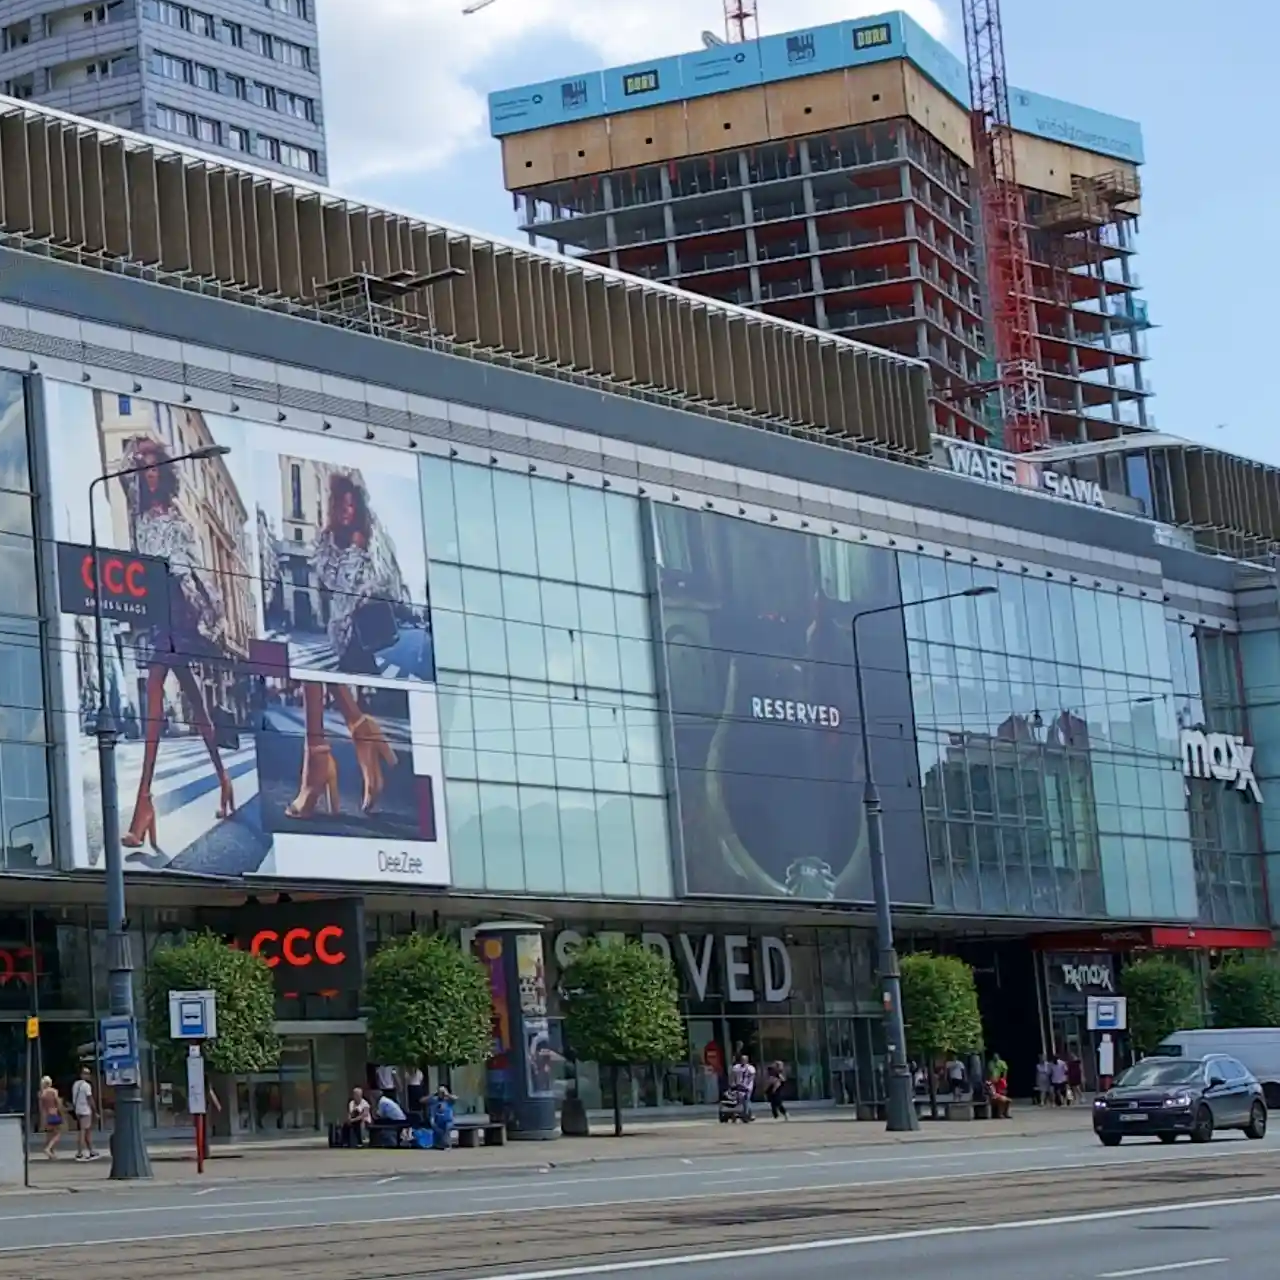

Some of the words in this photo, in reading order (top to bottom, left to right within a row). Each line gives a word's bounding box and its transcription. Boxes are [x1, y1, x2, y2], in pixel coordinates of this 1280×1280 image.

[948, 445, 1017, 485] WARS
[1043, 471, 1106, 508] SAWA
[81, 555, 148, 597] CCC
[751, 696, 840, 727] RESERVED
[377, 850, 422, 875] DeeZee
[251, 926, 346, 968] CCC
